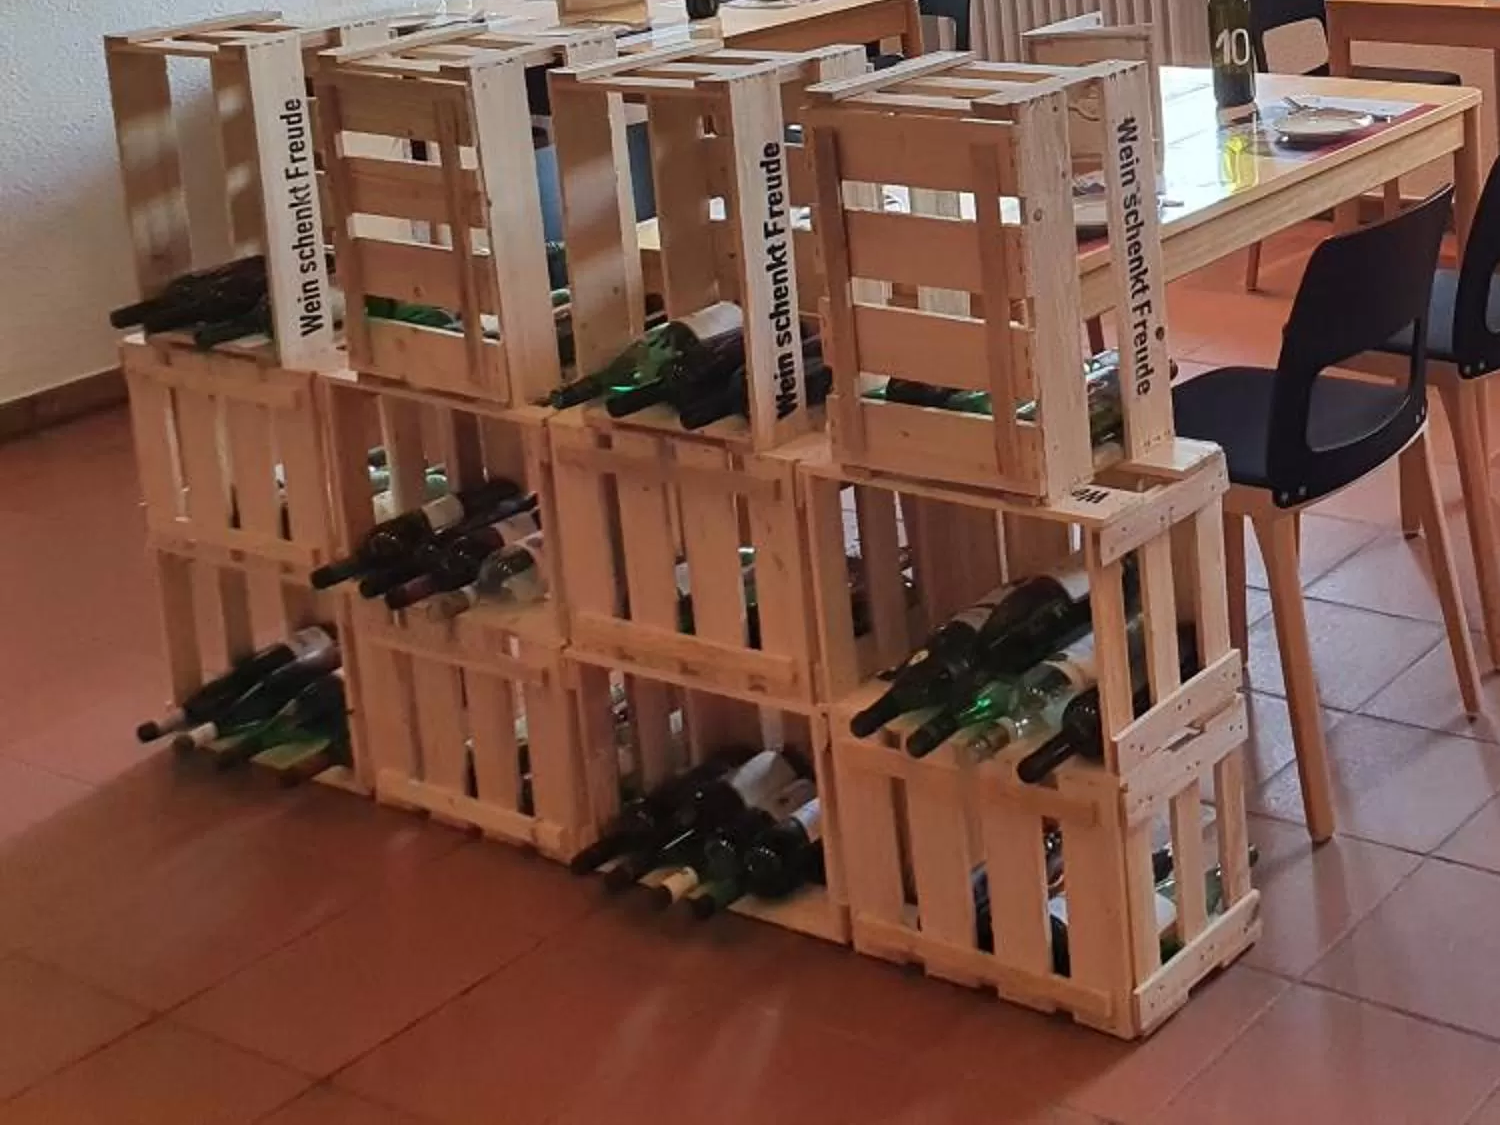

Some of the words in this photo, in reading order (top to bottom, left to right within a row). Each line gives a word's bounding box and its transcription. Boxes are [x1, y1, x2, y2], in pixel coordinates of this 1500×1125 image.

[1215, 28, 1250, 66] 10
[280, 98, 308, 180] Freude
[1117, 116, 1140, 187] Wein
[288, 183, 318, 274] schenkt
[760, 142, 786, 239] Freude
[1123, 193, 1150, 299] schenkt
[296, 286, 323, 337] Wein
[766, 242, 792, 348] schenkt
[774, 352, 798, 419] Wein
[1131, 299, 1154, 396] Freude
